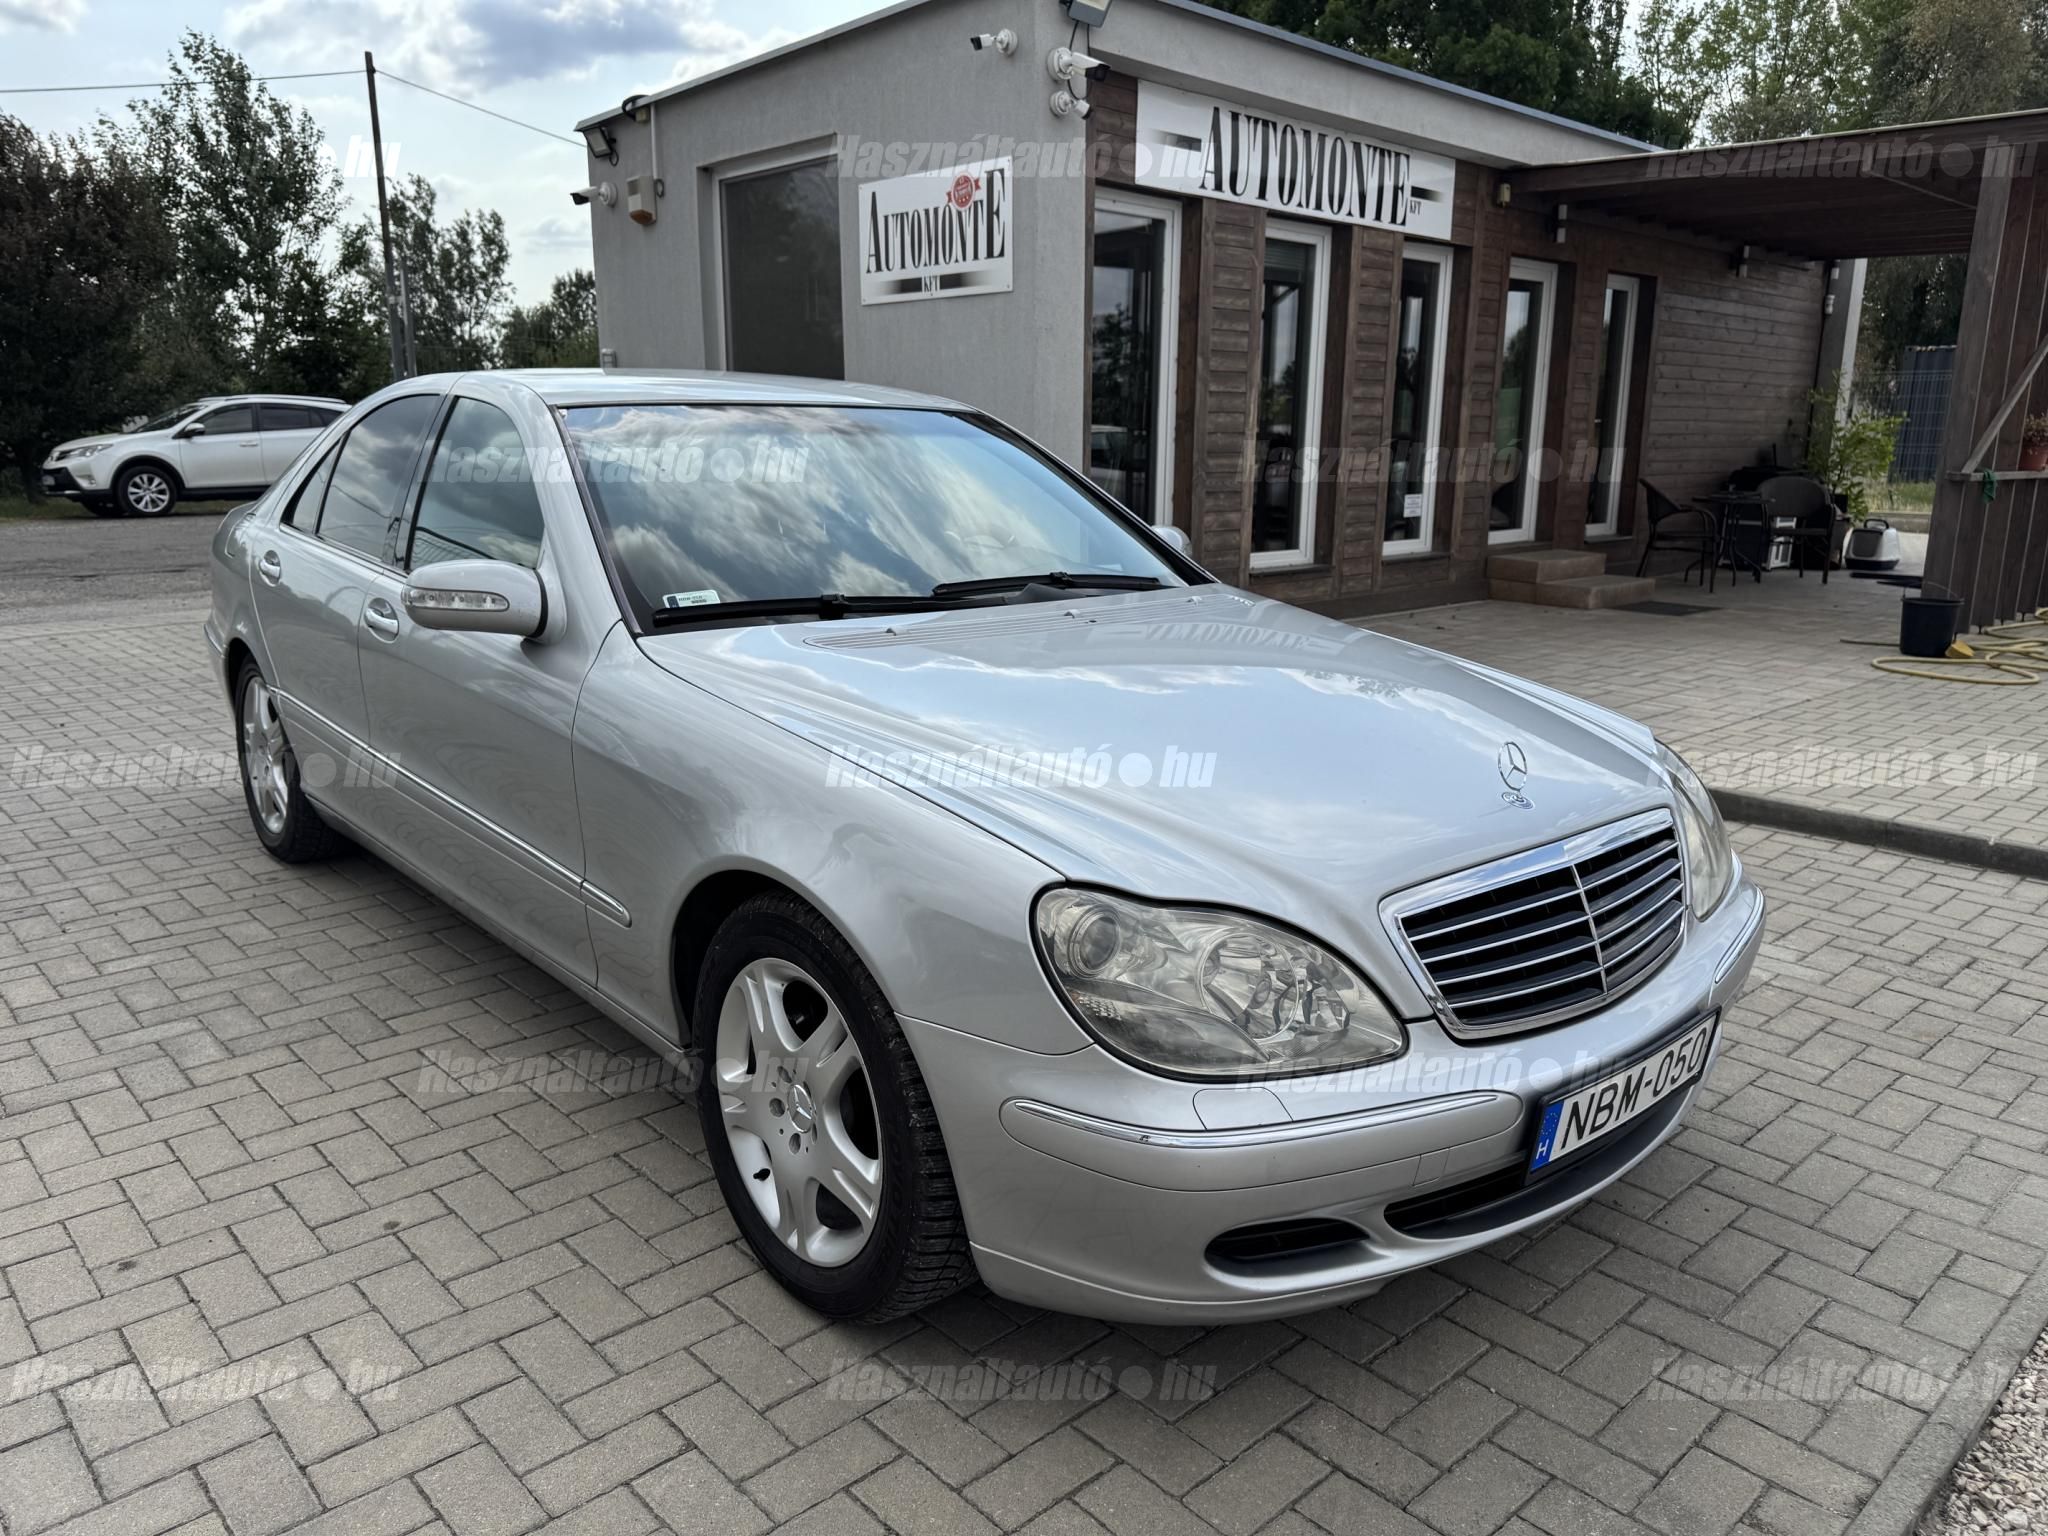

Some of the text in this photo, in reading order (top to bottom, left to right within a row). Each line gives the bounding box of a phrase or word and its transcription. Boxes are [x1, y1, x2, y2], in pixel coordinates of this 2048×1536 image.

[1199, 106, 1411, 227] AUTOMONTE
[866, 168, 1006, 274] AUTOMONTE
[923, 275, 940, 293] KFT
[1561, 1027, 1707, 1150] NBM-050
[1535, 1139, 1550, 1160] H
